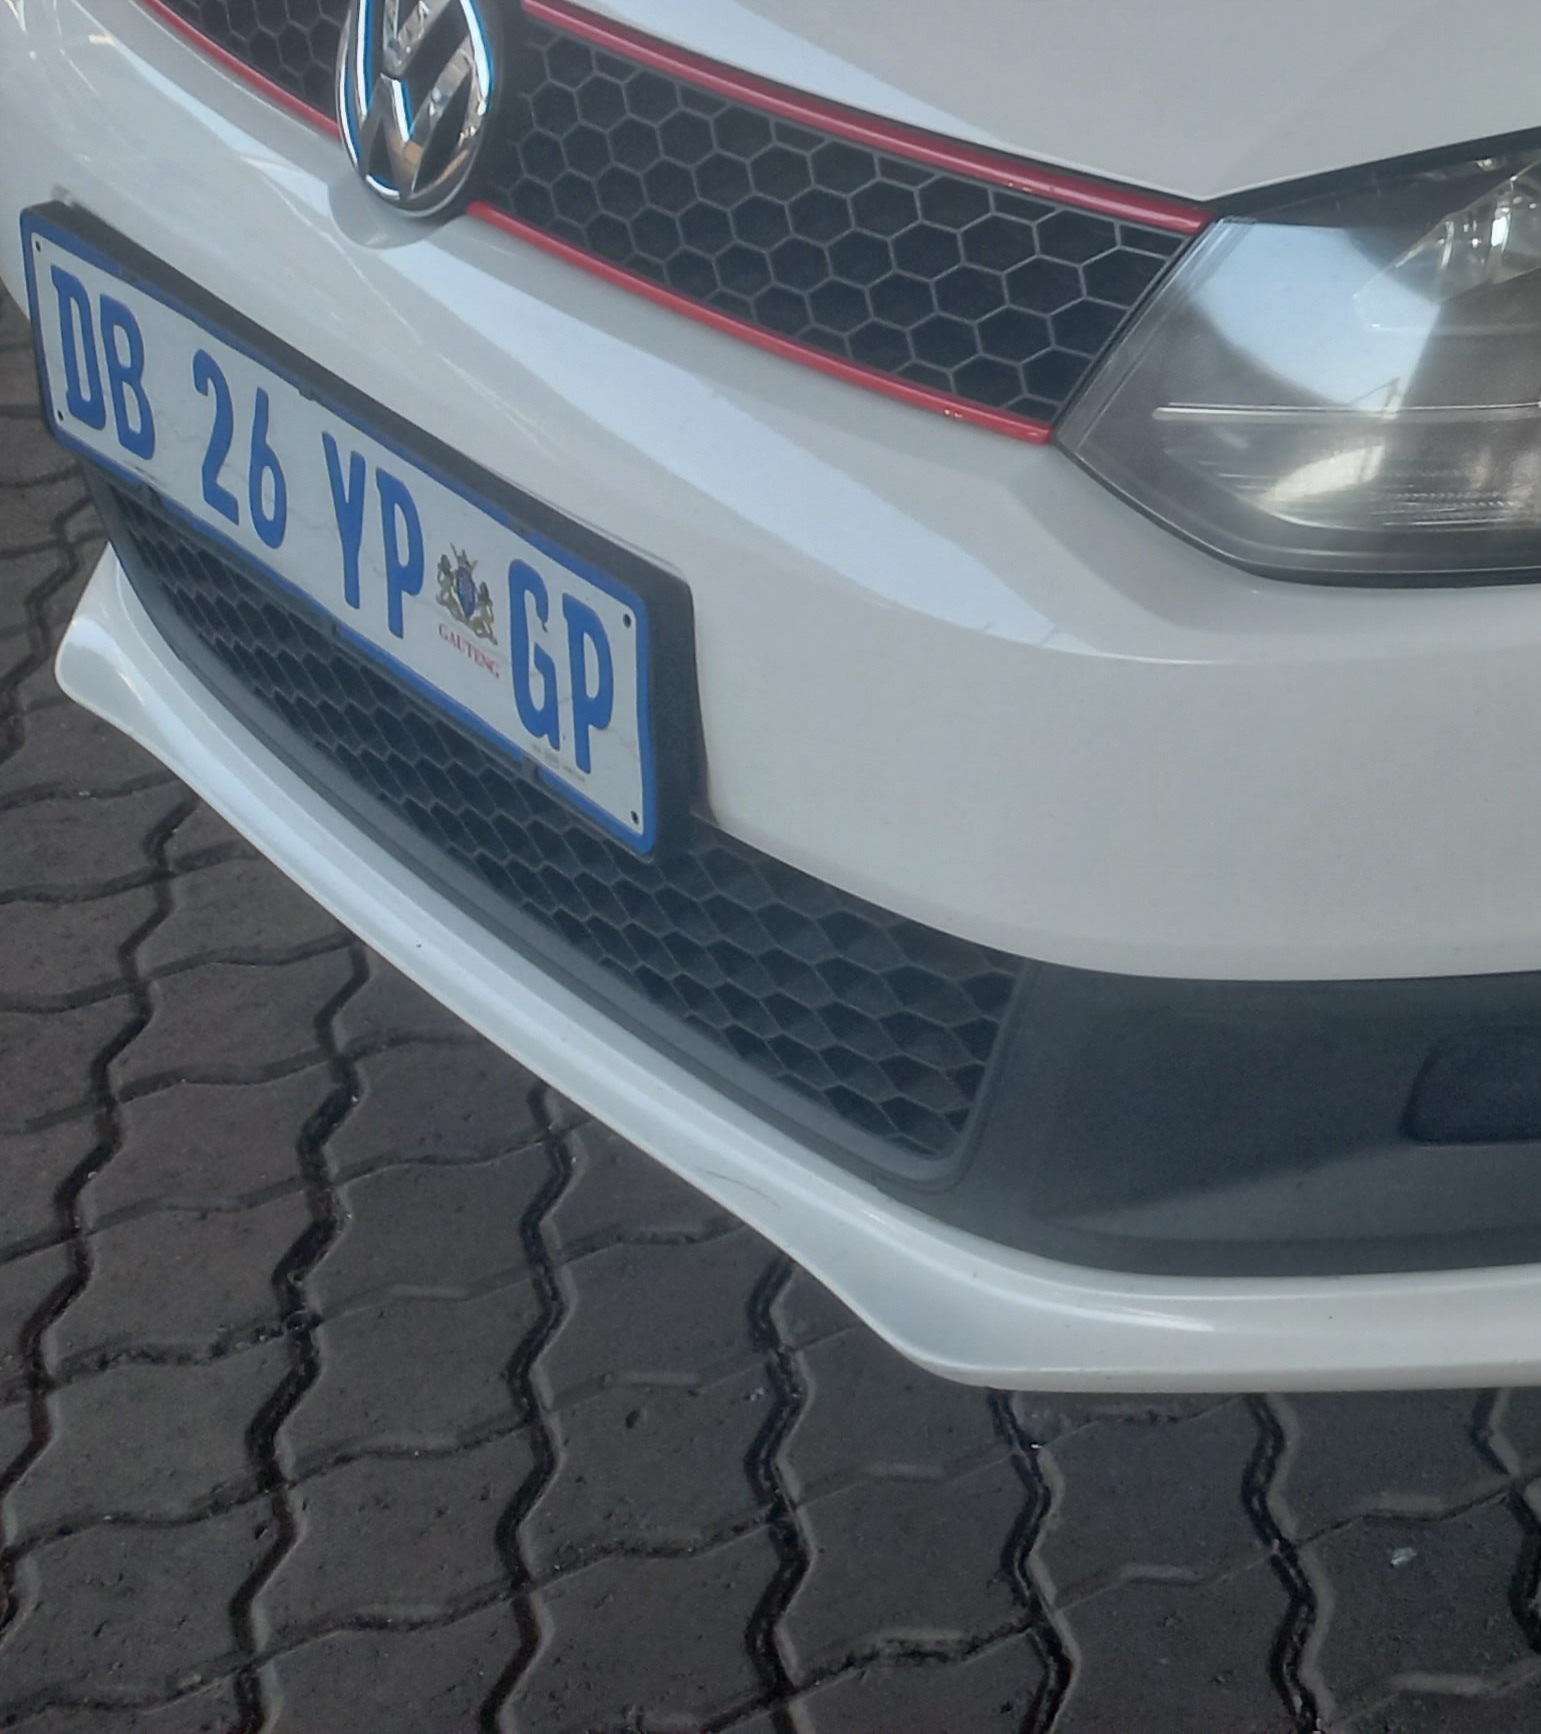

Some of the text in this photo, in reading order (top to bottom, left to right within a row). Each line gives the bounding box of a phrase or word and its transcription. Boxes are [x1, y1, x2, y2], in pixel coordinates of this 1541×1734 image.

[50, 263, 614, 775] DB 26 YP GP
[438, 622, 500, 678] GAUTENG
